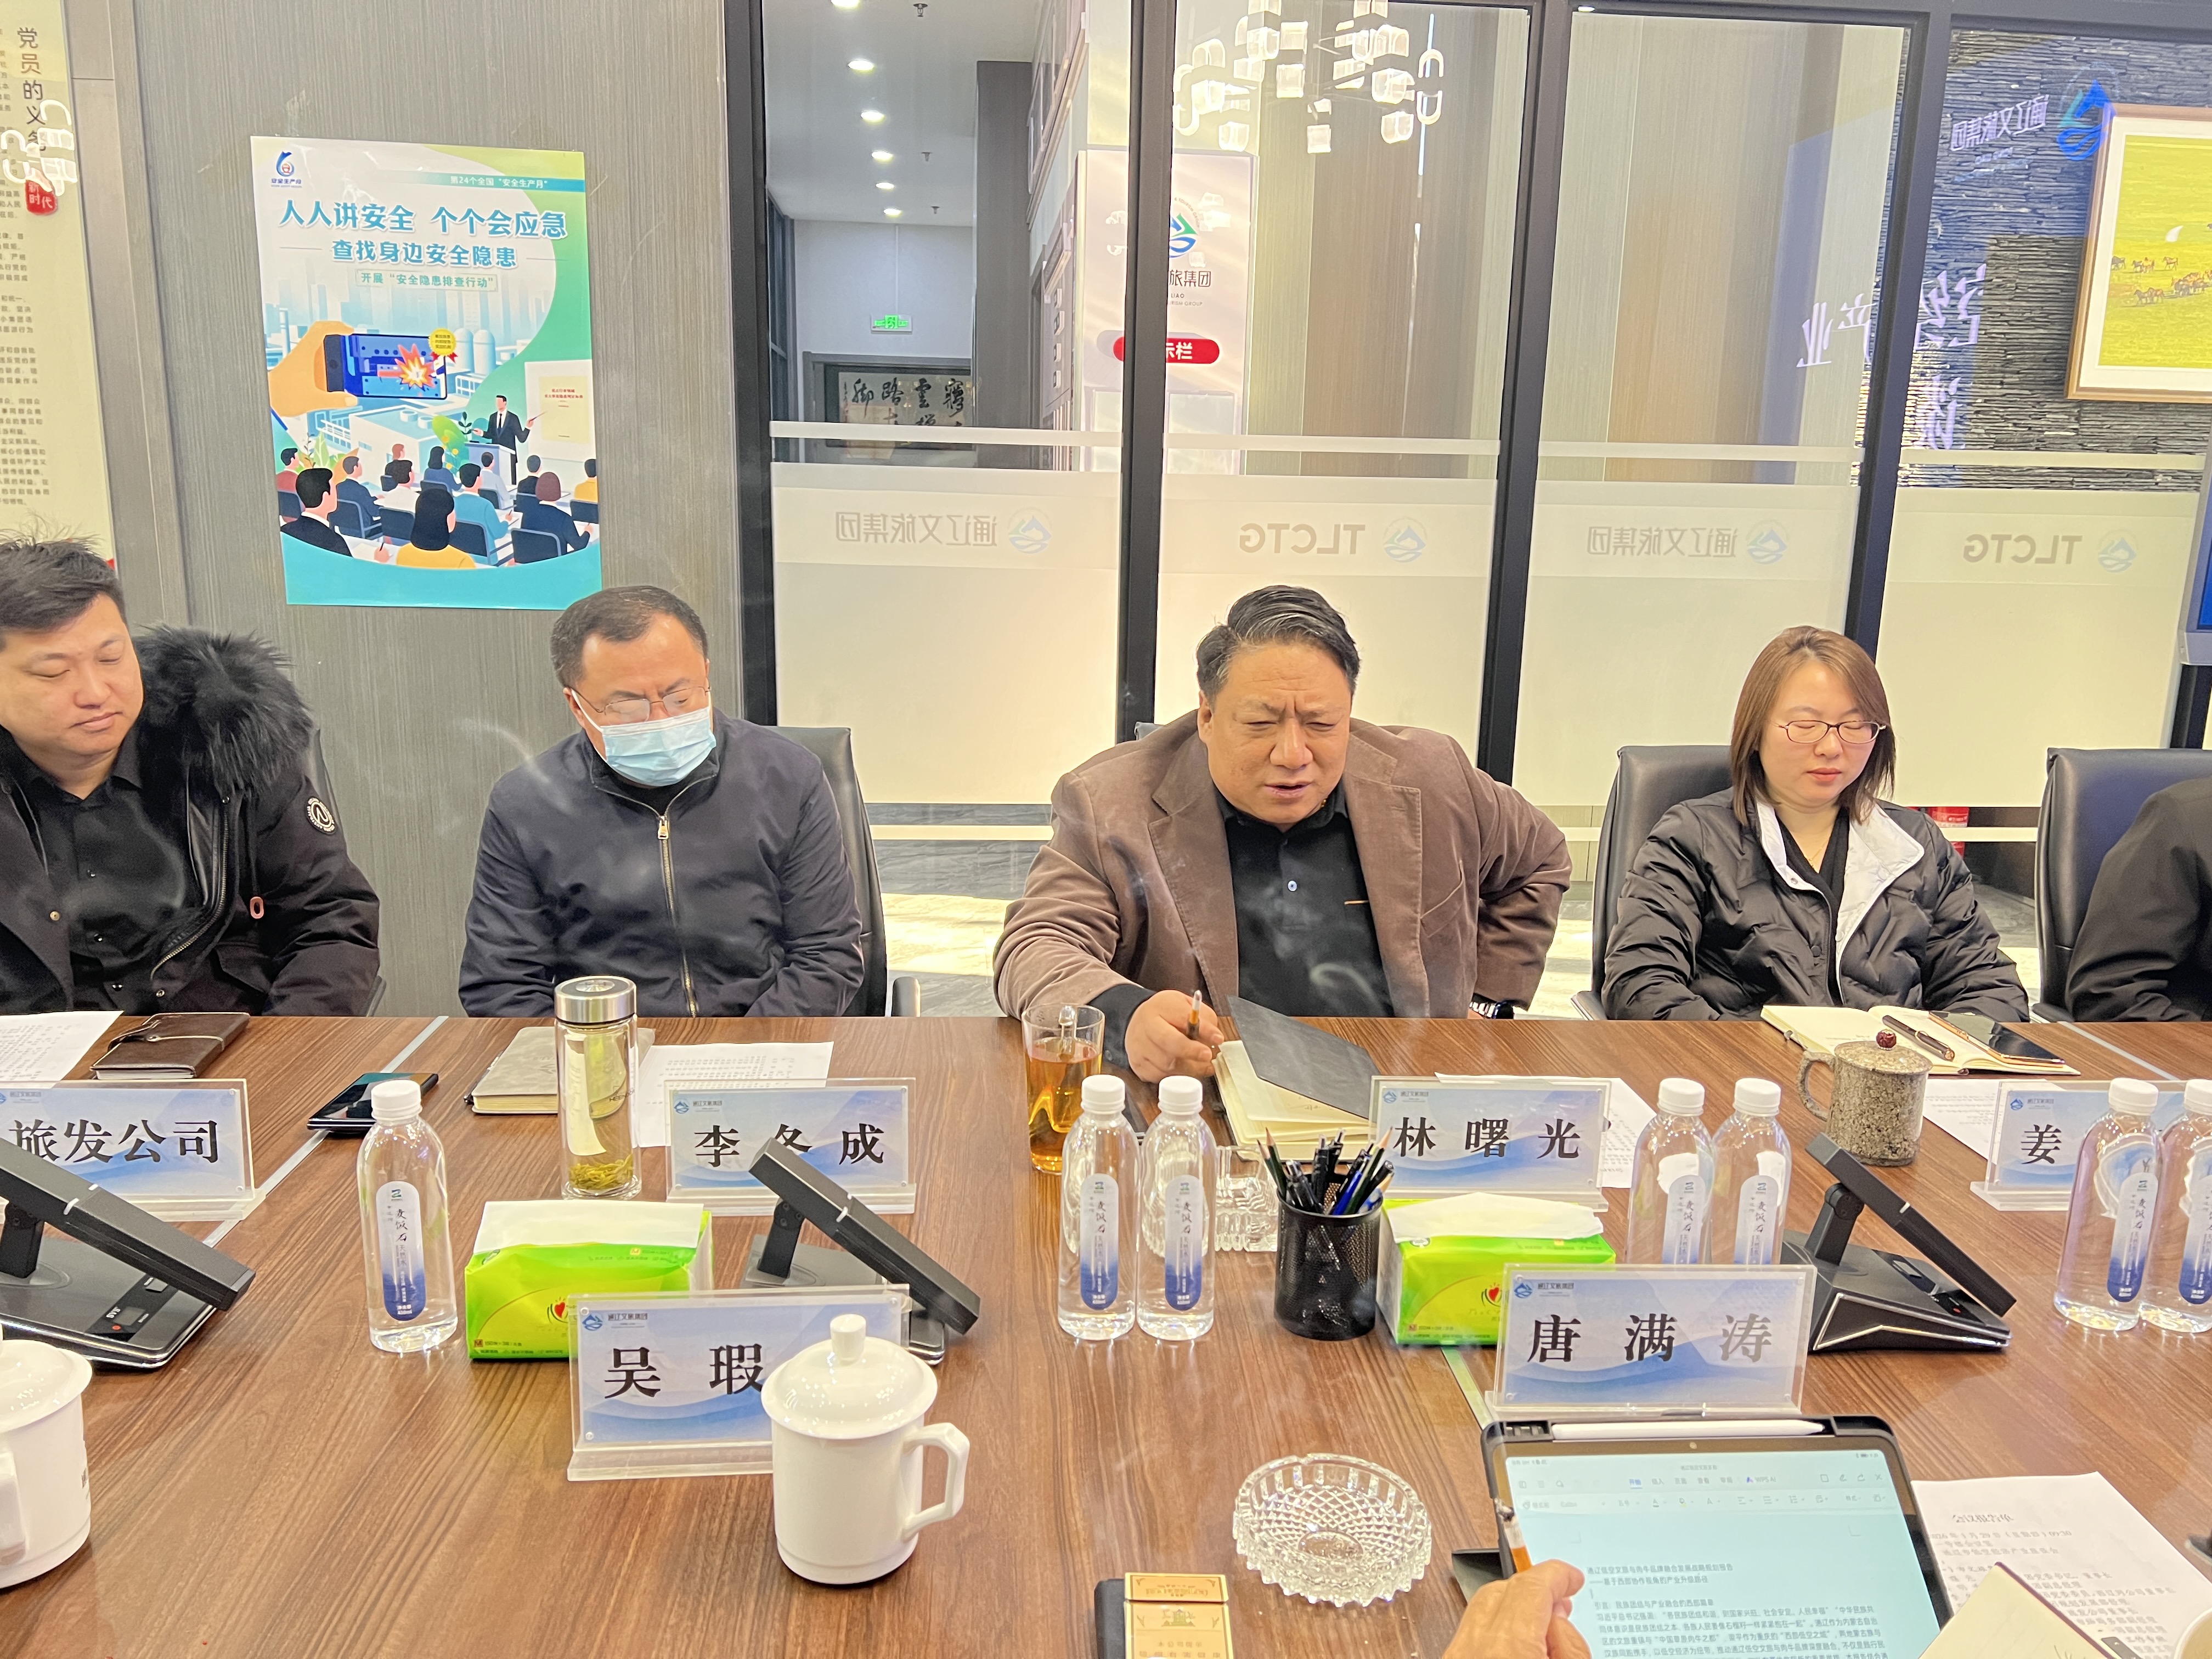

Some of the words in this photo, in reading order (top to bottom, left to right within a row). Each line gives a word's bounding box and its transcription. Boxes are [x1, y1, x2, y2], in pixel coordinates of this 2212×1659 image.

[279, 199, 414, 231] 人人讲安全
[430, 206, 567, 238] 个个会应急
[332, 239, 516, 267] 查找身边安全隐患
[9, 1119, 218, 1164] 旅发公司
[1393, 1117, 1581, 1160] 林曙光
[1527, 1313, 1773, 1363] 唐满涛
